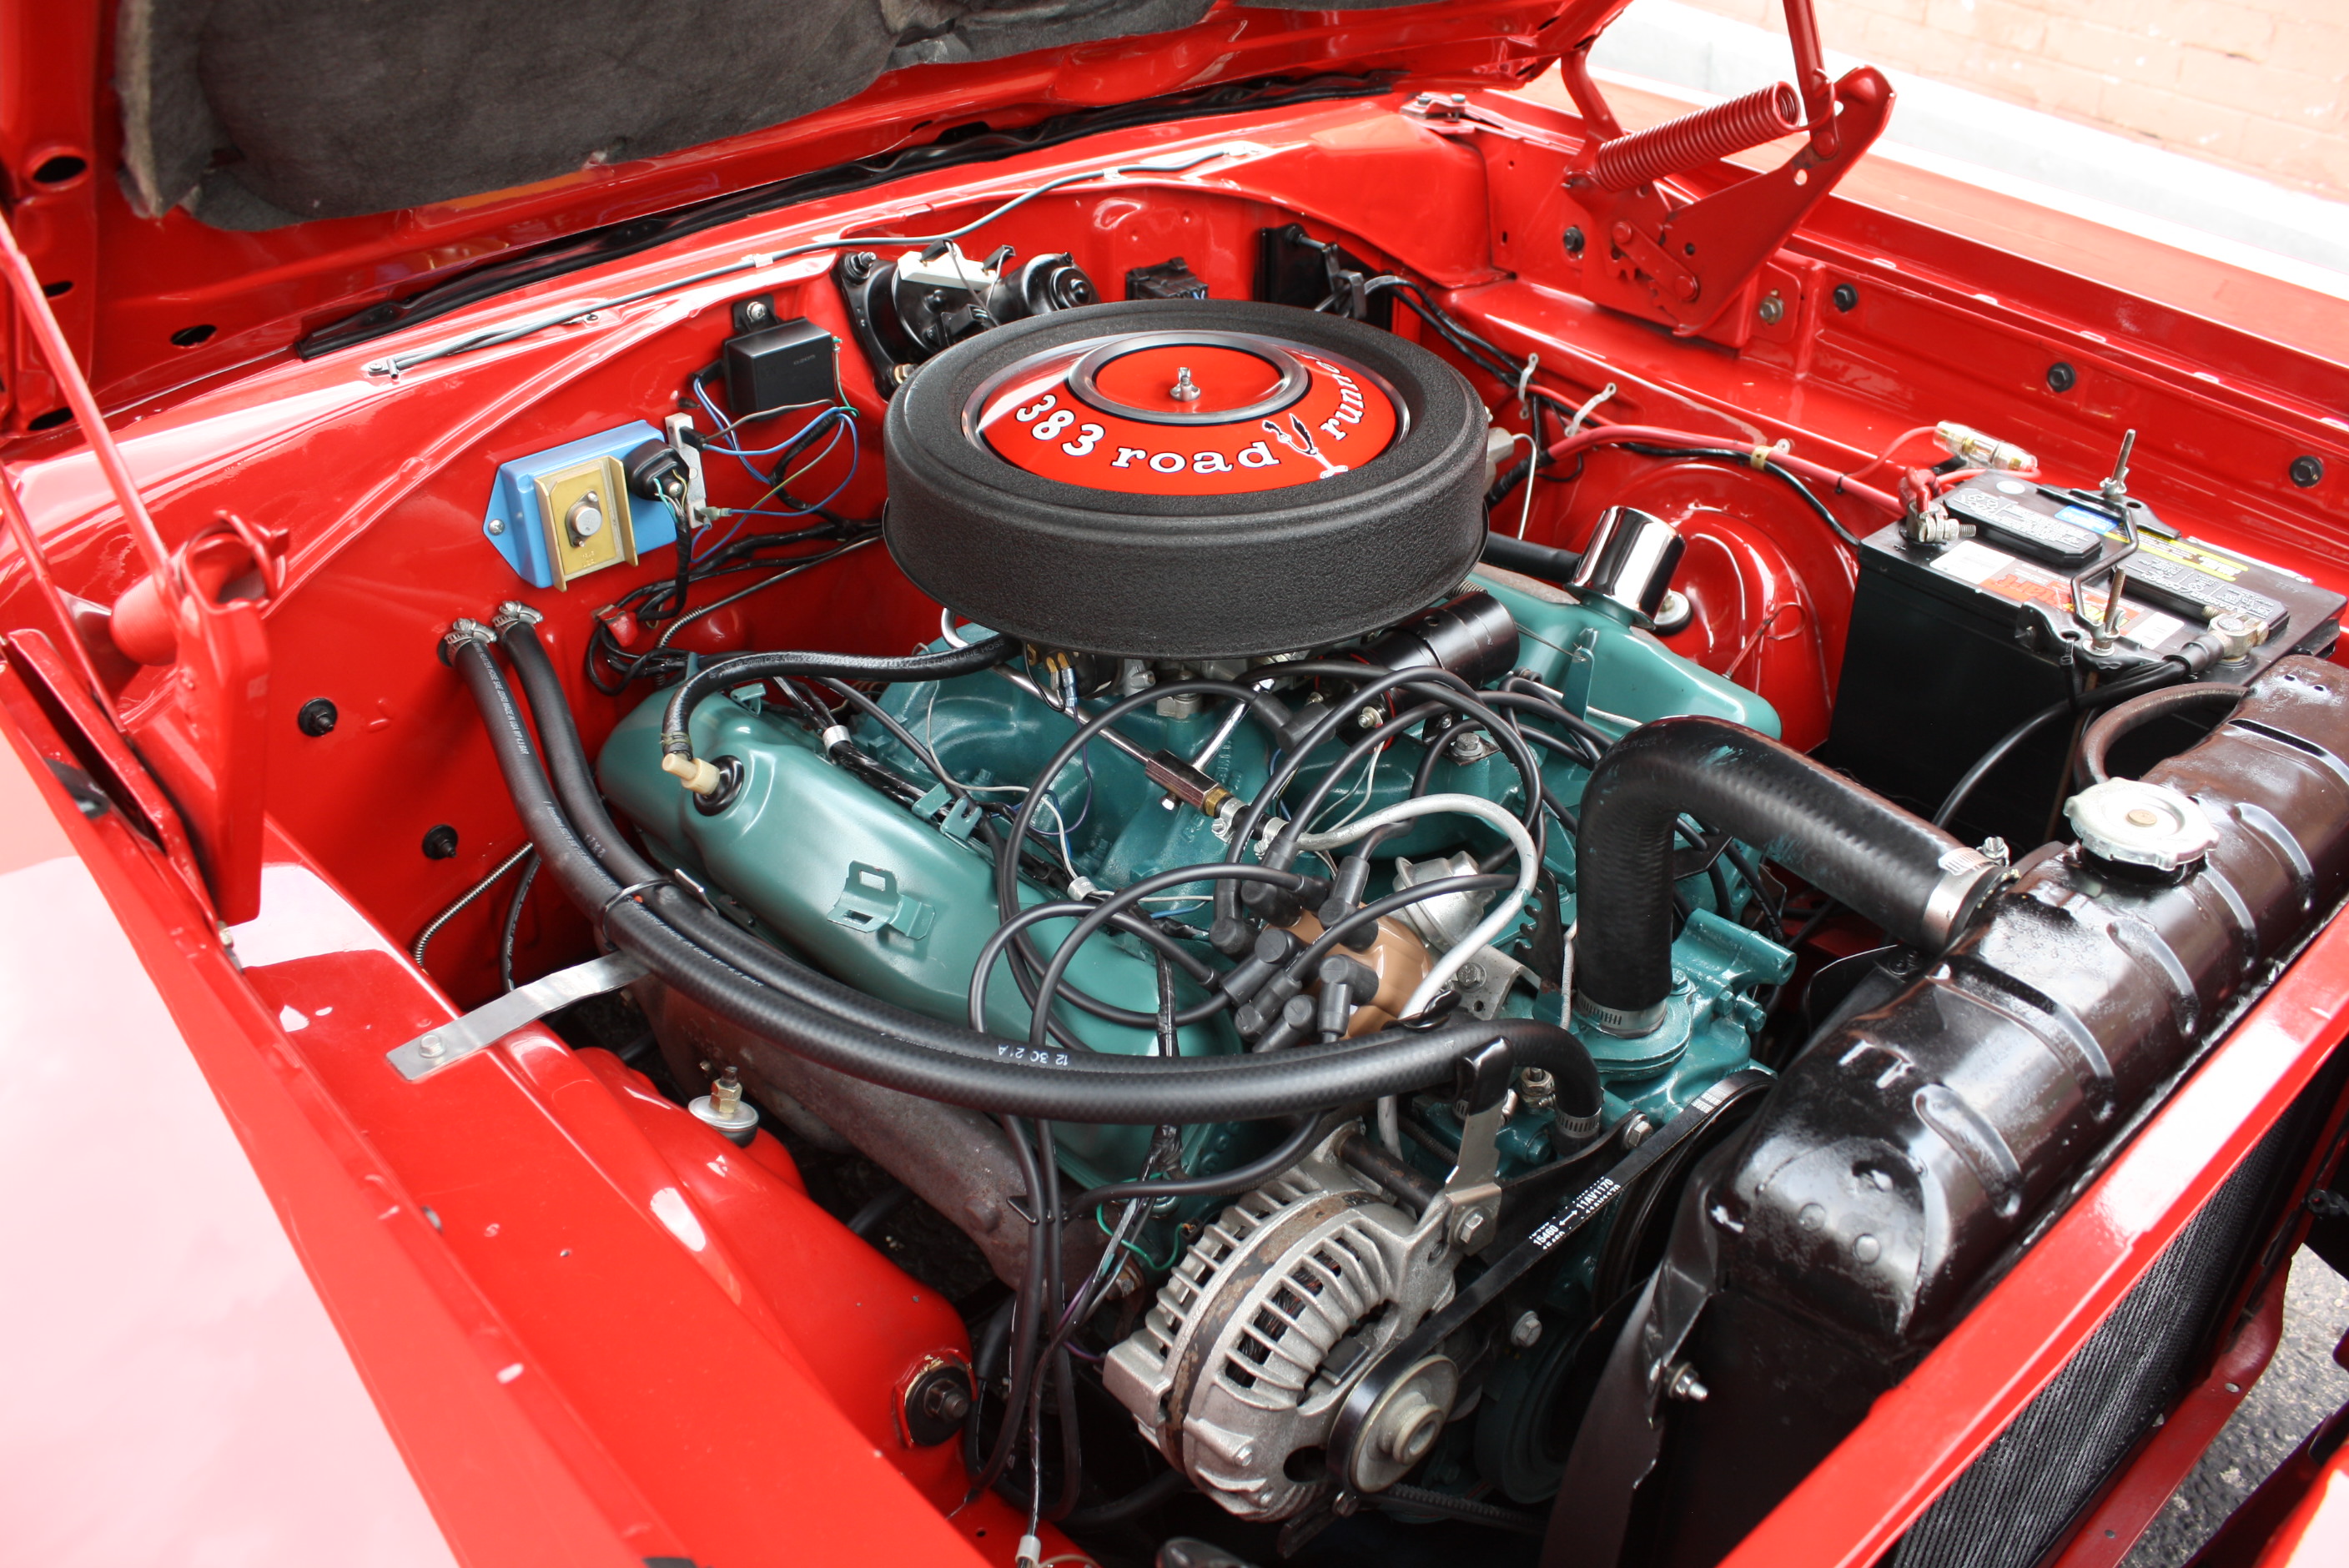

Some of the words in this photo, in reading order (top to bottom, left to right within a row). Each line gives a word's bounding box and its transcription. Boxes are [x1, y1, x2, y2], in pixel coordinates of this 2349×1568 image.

[1016, 394, 1106, 457] 383
[1110, 440, 1280, 474] road
[919, 654, 958, 668] RETURN
[958, 648, 980, 662] LINE
[980, 638, 1006, 655] HOSE
[1055, 1053, 1069, 1066] 12
[1532, 1224, 1559, 1247] 15460
[1576, 1178, 1614, 1210] 11AV1170
